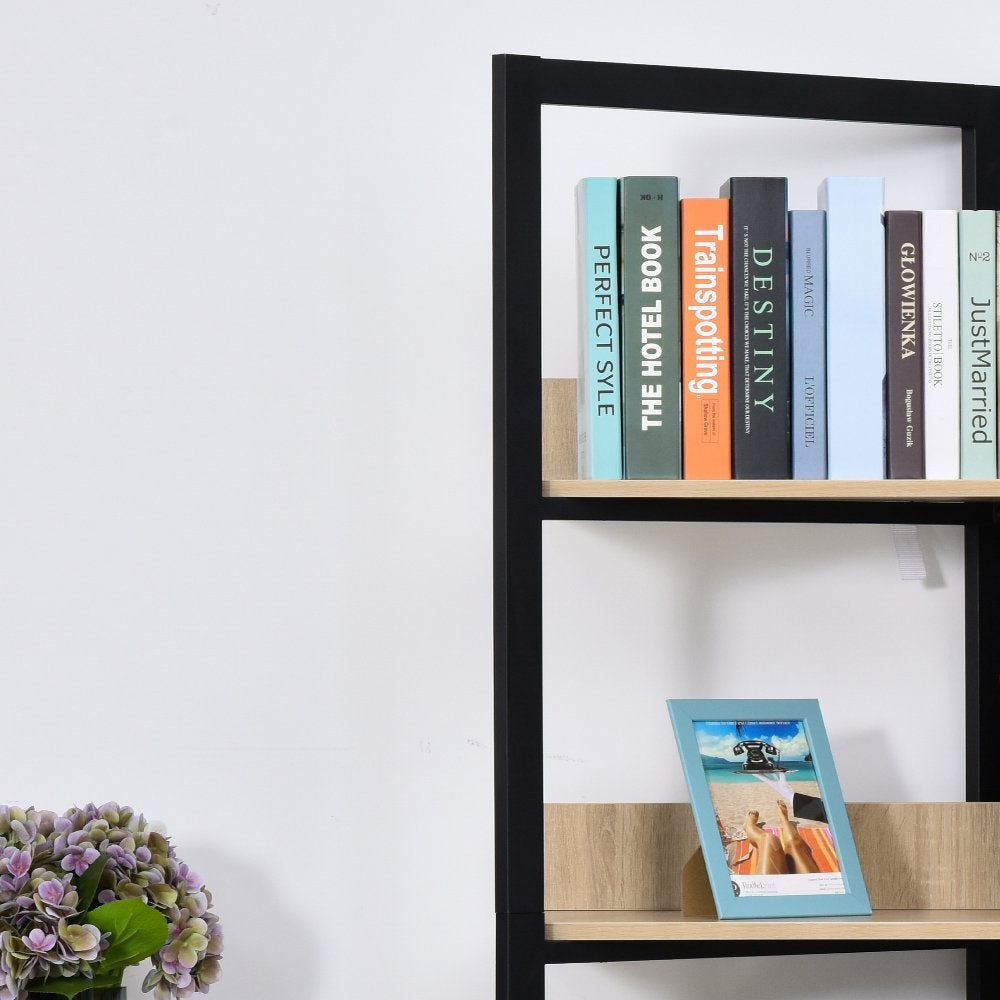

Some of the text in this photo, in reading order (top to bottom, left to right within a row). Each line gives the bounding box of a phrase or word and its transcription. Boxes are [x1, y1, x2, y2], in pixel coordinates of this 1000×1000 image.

[593, 245, 615, 417] PERFECT SYLE
[641, 225, 662, 431] THE HOTEL BOOK
[688, 225, 725, 395] Trainspotting
[752, 248, 774, 413] DESTINY
[803, 275, 814, 317] MAGIC
[804, 377, 815, 448] L'OFFICIEL
[905, 425, 914, 448] Guzik
[933, 357, 943, 386] BOOK
[970, 297, 992, 444] JustMarried
